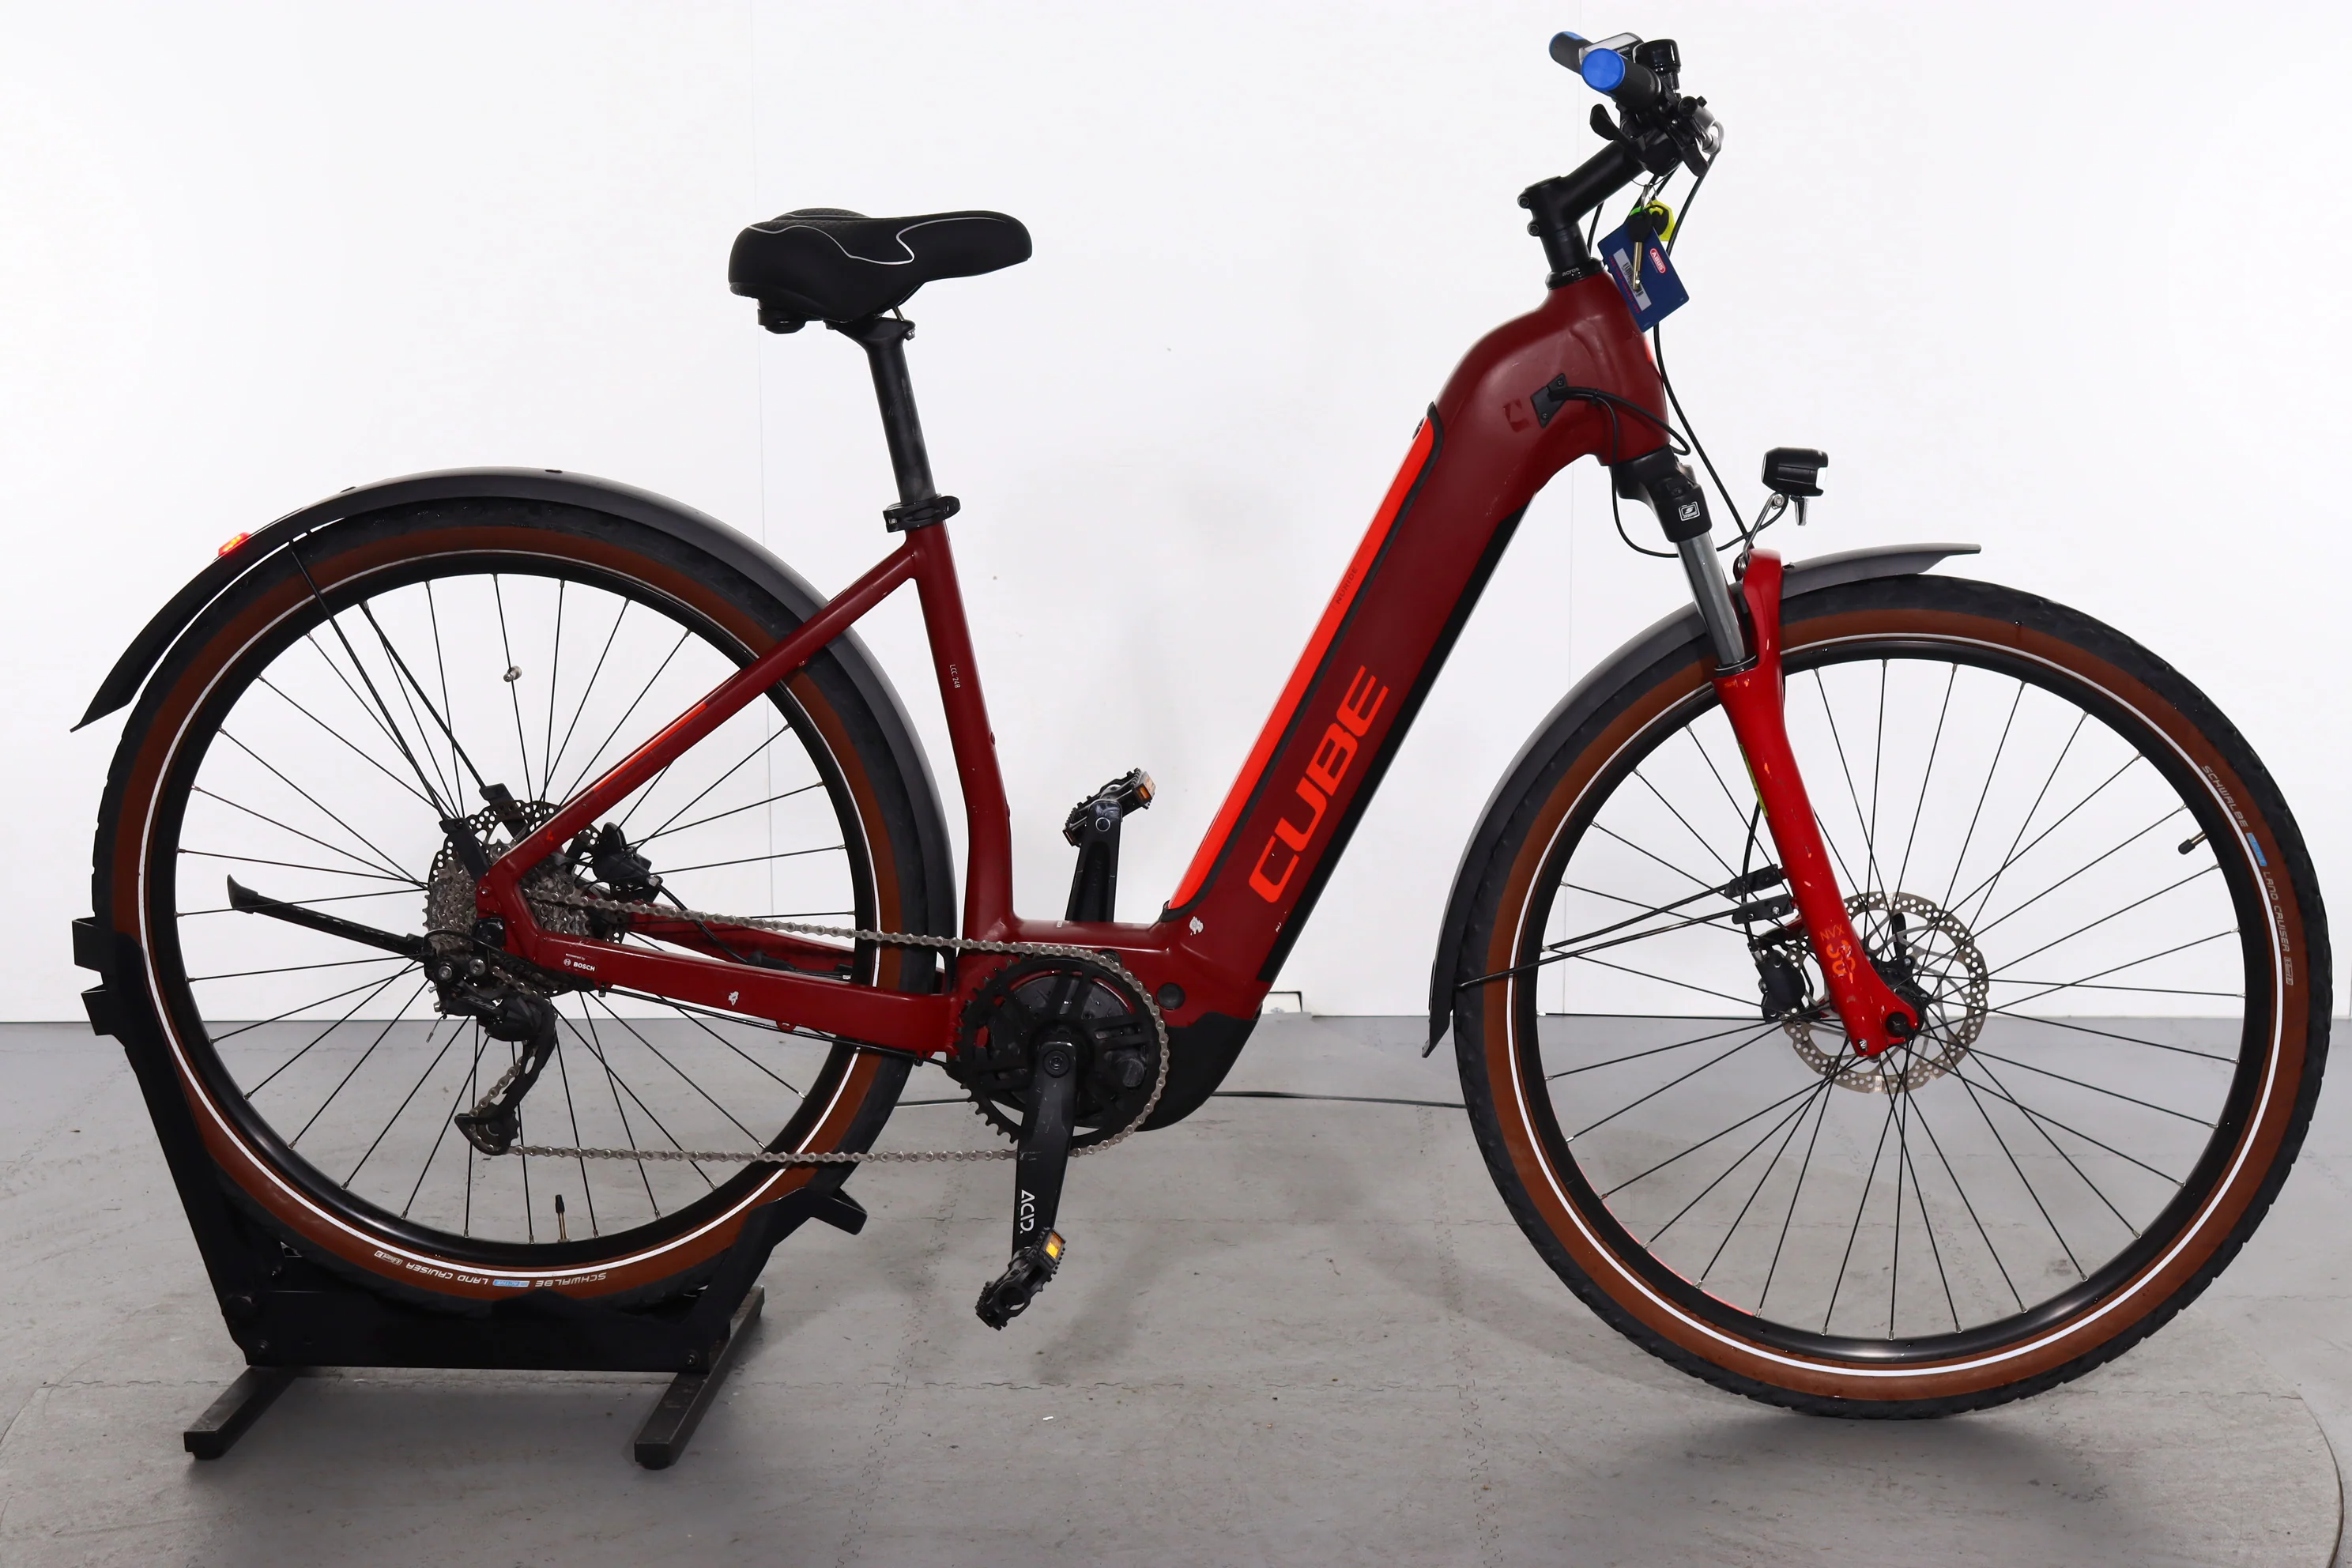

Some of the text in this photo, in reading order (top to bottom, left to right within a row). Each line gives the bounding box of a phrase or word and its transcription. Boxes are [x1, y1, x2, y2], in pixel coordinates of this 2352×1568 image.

[1650, 251, 1665, 273] ABUS
[1249, 665, 1389, 903] CUBE
[2201, 765, 2248, 827] SCHWALBE
[2263, 871, 2279, 901] LAND
[2273, 905, 2290, 952] CRUISER
[1819, 924, 1845, 941] NVX
[573, 961, 596, 972] BOSCH
[405, 1262, 454, 1280] CRUISER
[457, 1274, 489, 1285] LAND
[535, 1272, 607, 1287] SCHWALBE
